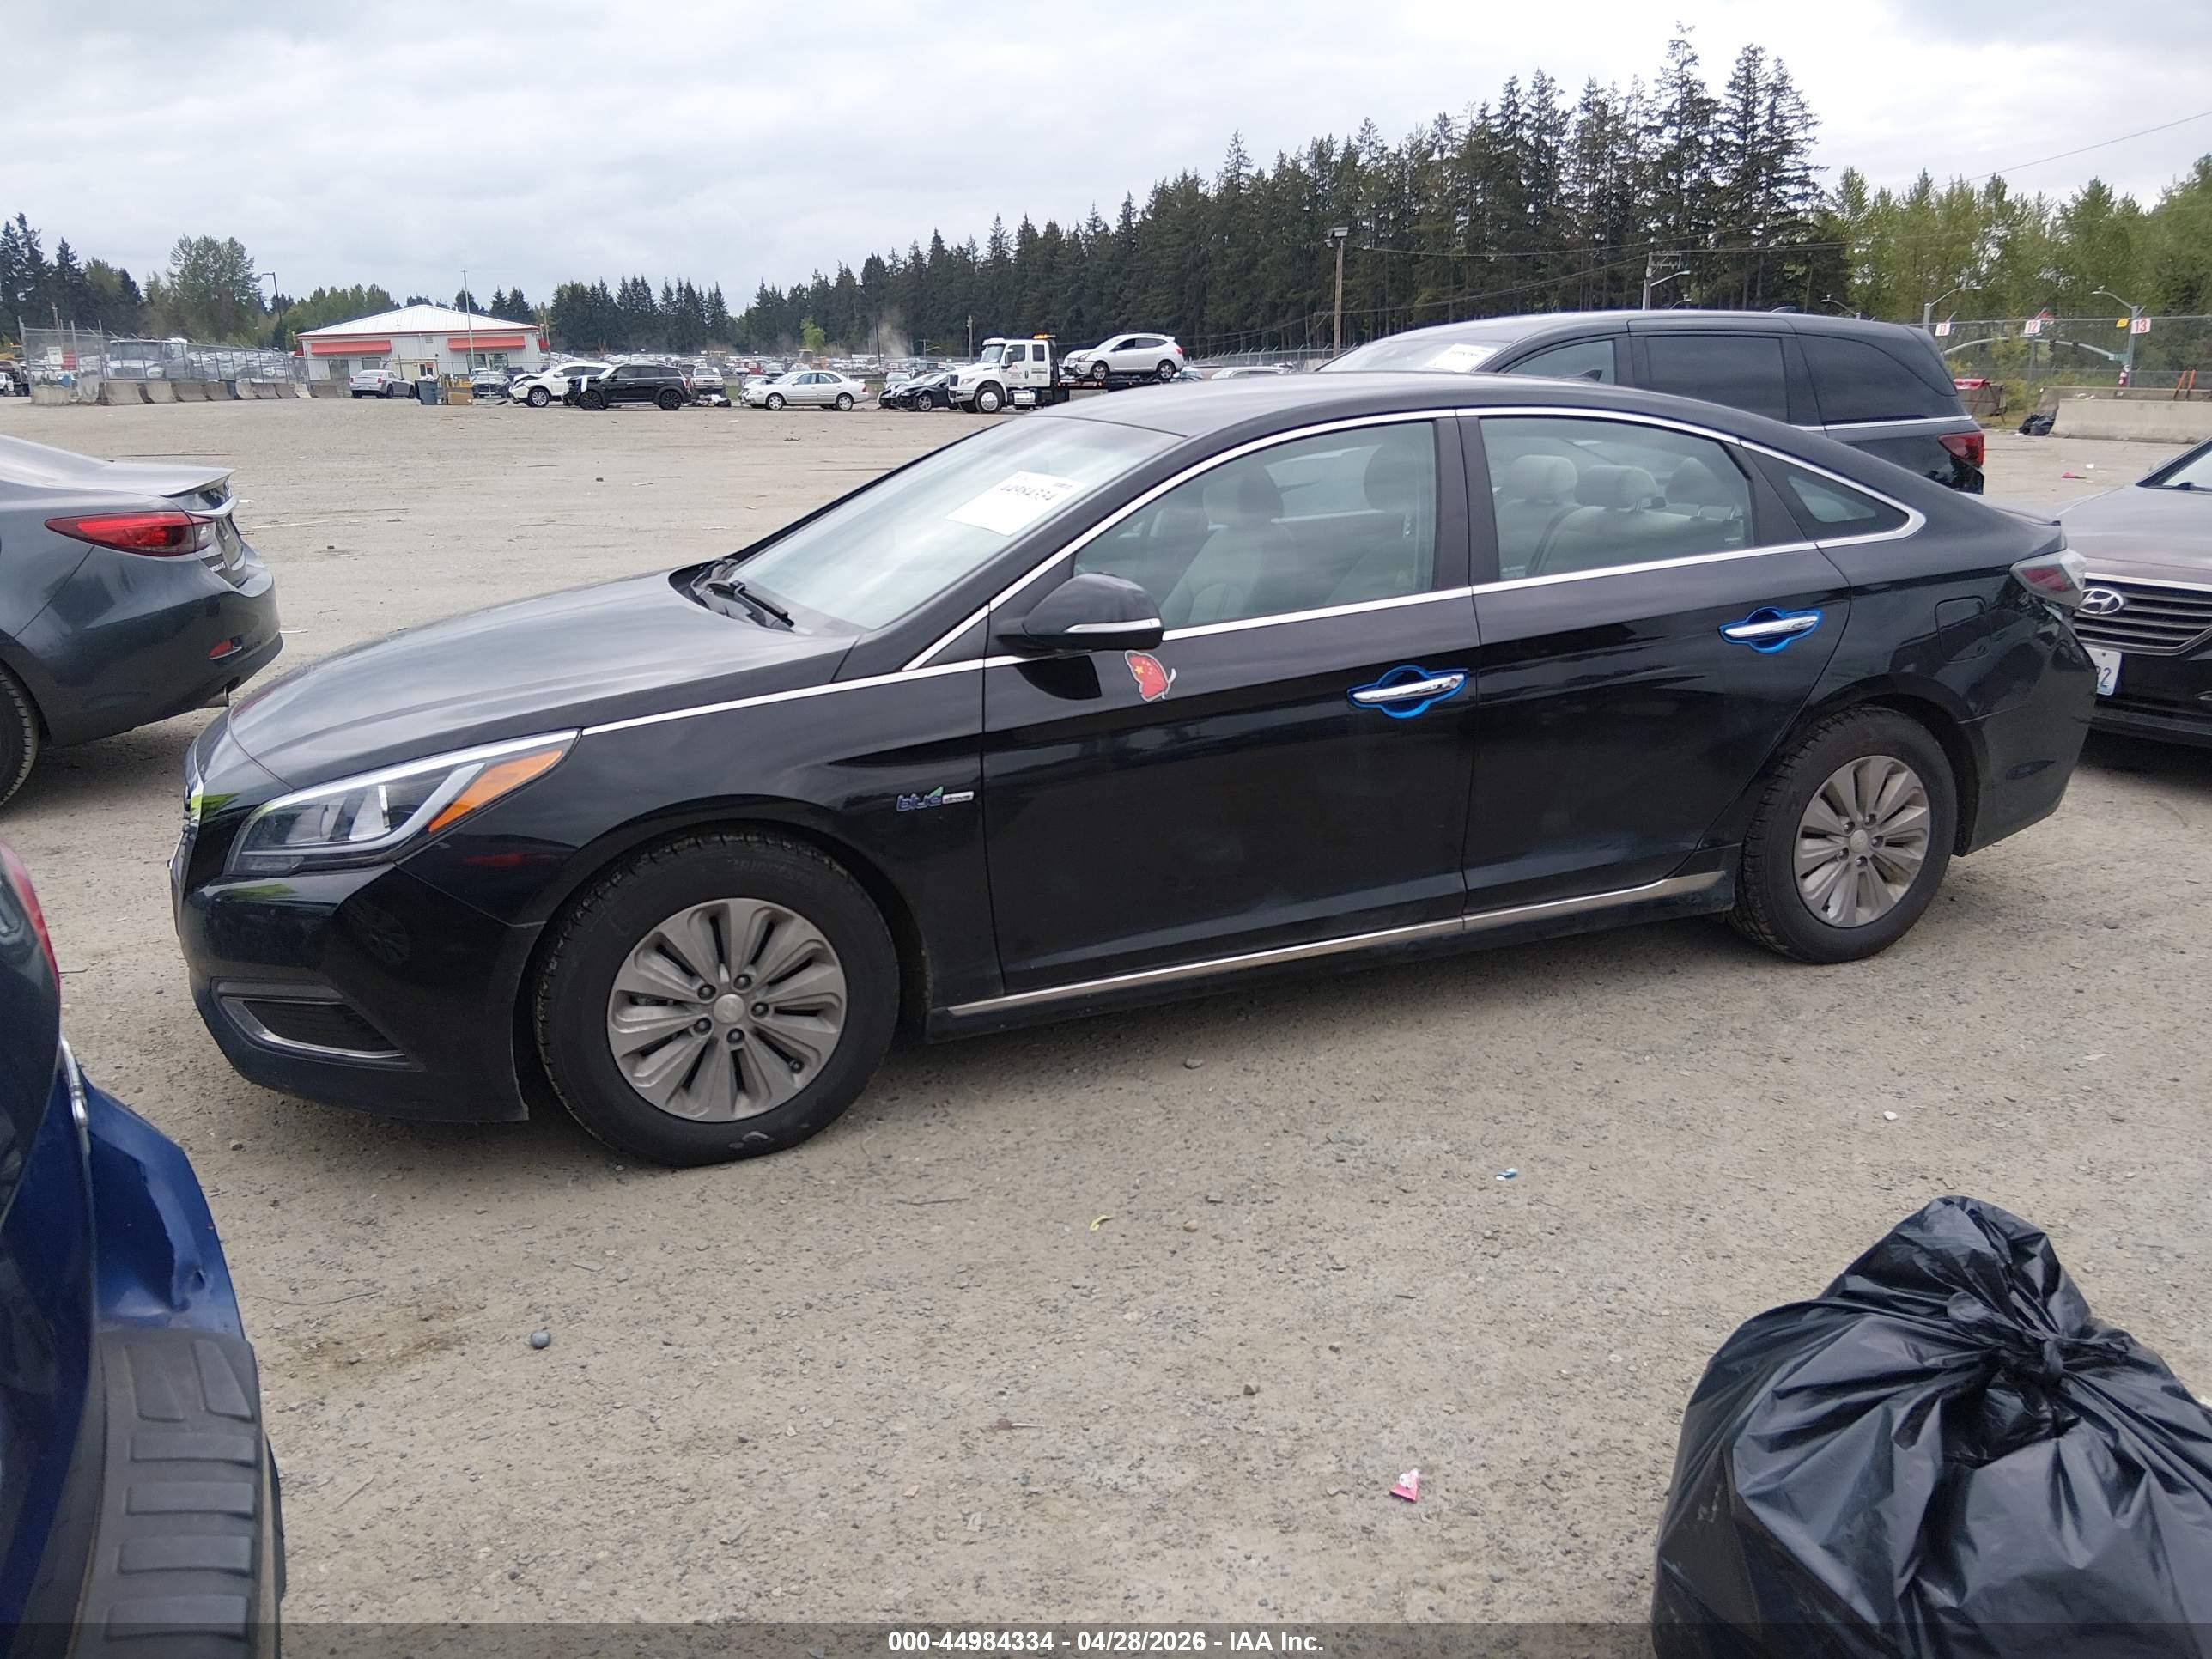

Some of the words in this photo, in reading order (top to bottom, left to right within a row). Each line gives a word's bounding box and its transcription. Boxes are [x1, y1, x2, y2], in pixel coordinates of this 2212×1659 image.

[1939, 324, 1948, 335] 11
[2027, 321, 2039, 333] 12
[2136, 319, 2148, 333] 13
[896, 789, 944, 812] blue
